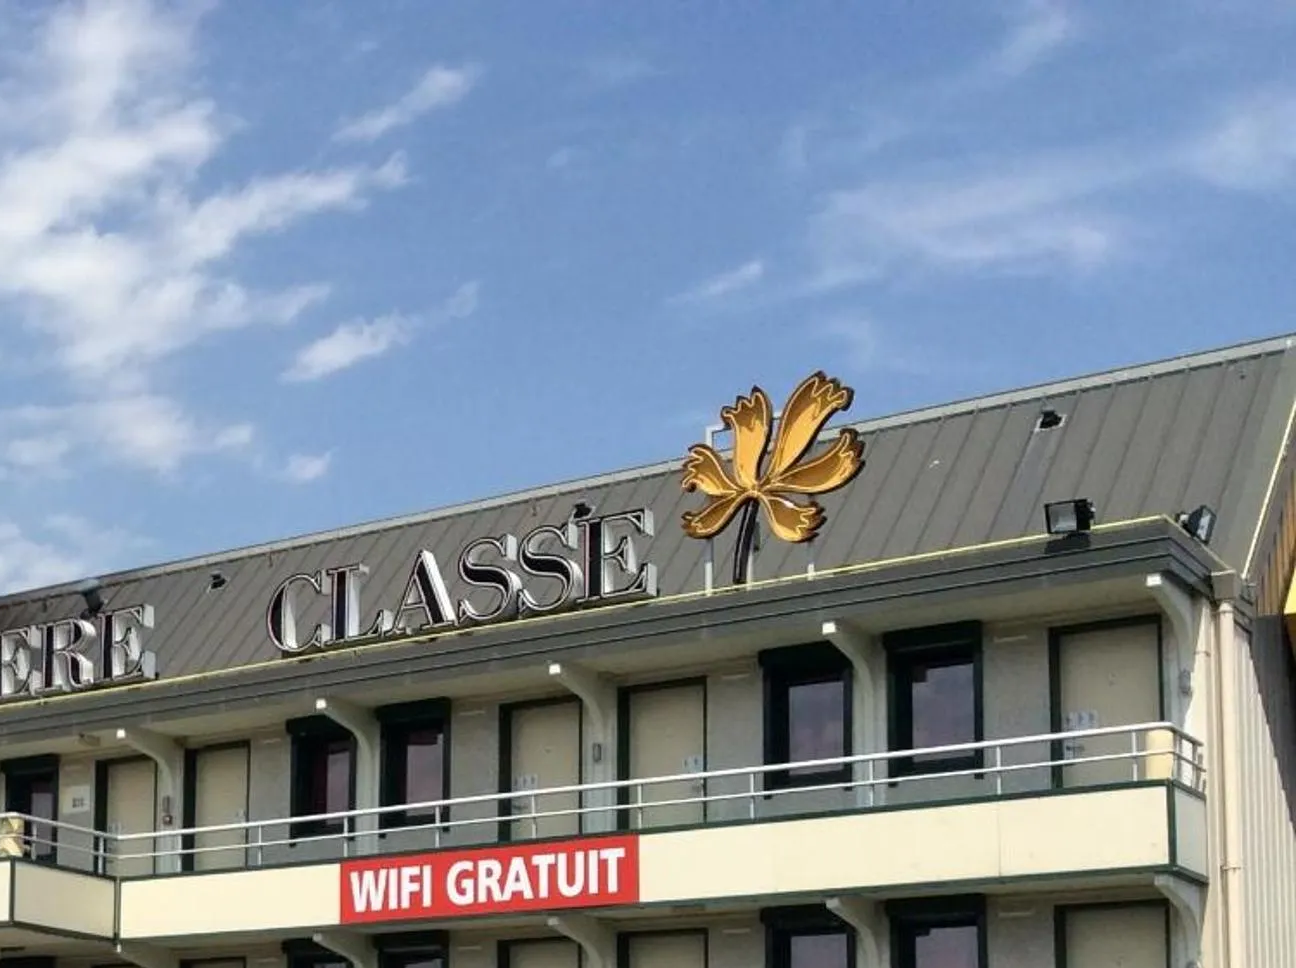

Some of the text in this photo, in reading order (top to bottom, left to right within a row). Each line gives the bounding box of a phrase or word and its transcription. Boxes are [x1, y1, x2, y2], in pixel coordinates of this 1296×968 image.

[266, 507, 656, 656] CLASSE
[350, 847, 626, 913] WIFI GRATUIT
